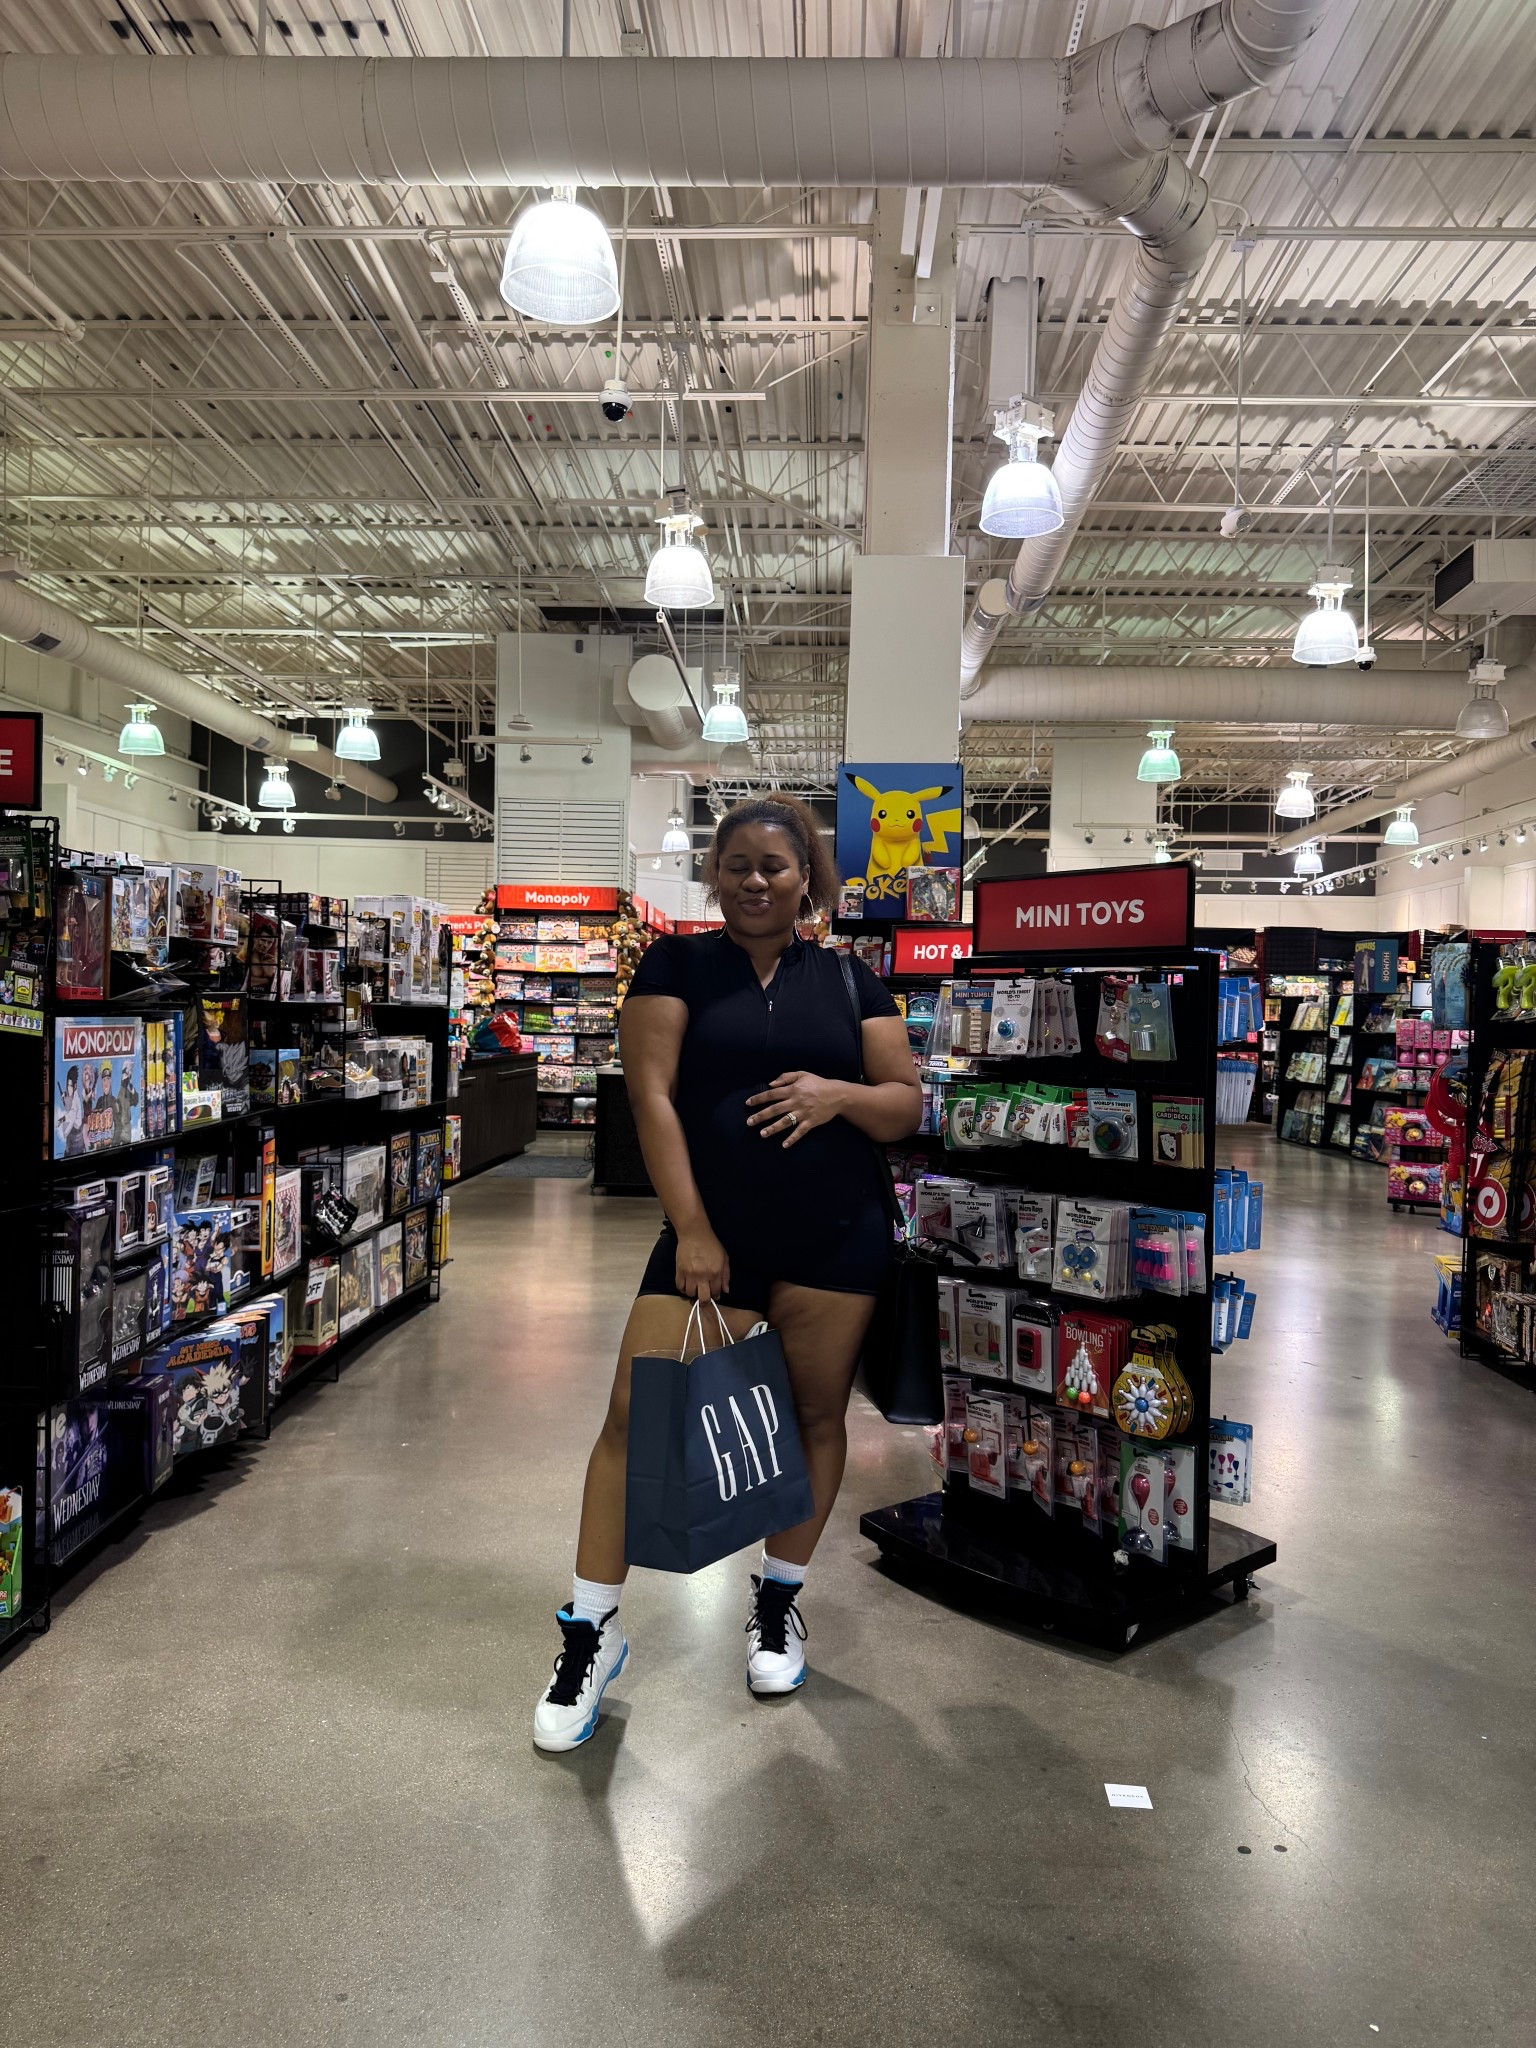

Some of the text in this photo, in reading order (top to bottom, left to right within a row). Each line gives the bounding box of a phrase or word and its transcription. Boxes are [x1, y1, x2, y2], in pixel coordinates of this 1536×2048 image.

[525, 891, 590, 906] Monopoly
[1015, 899, 1145, 929] MINI TOYS
[913, 944, 949, 960] HOT
[950, 944, 963, 960] &
[11, 960, 39, 973] MINECRAFT
[1383, 952, 1391, 982] HUMOR
[65, 1030, 134, 1055] MONOPOLY
[1156, 1111, 1189, 1121] CARD DECK
[1071, 1217, 1097, 1226] PICKLEBALL
[307, 1282, 322, 1297] OFF
[1066, 1326, 1104, 1347] BOWLING
[111, 1335, 142, 1365] WEDNESDAY
[166, 1345, 233, 1369] ACADEMIA
[179, 1340, 220, 1355] MY HERO
[79, 1362, 108, 1393] WEDNESDAY
[107, 1400, 142, 1410] WEDNESDAY
[700, 1384, 783, 1502] GAP
[53, 1473, 101, 1534] WEDNESDAY
